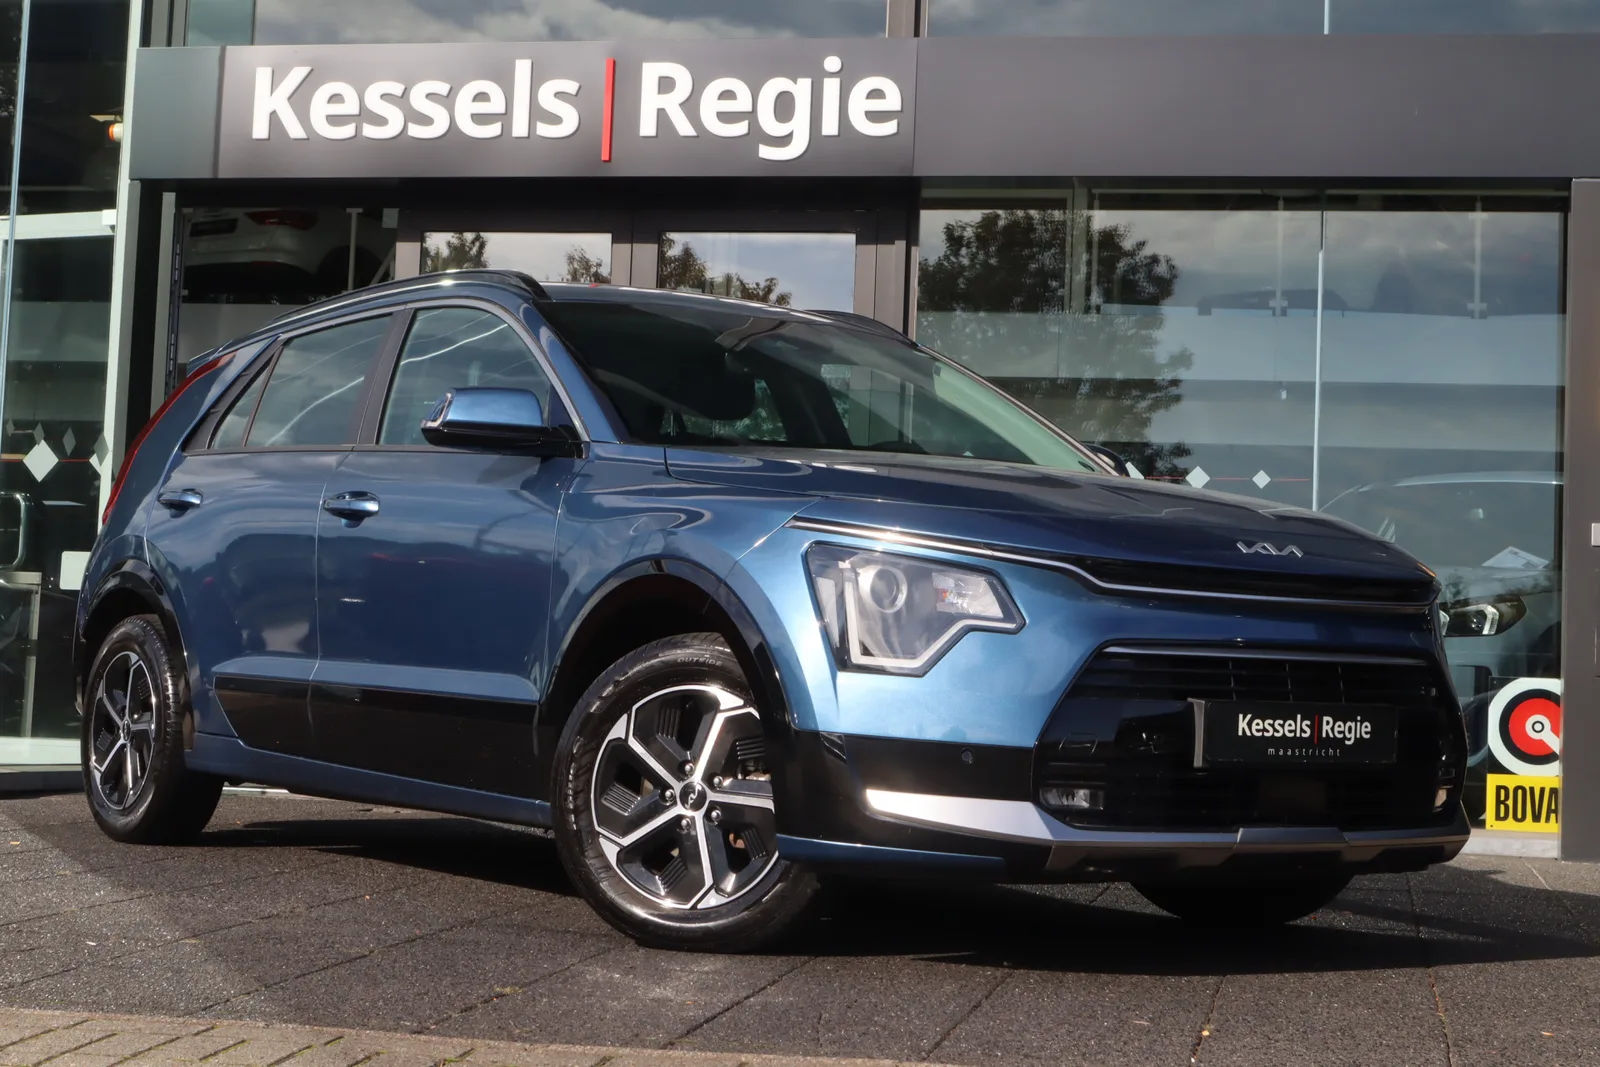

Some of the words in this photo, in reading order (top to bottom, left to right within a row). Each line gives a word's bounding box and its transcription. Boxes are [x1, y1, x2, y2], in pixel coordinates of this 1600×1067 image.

[251, 59, 580, 140] Kessels
[639, 55, 903, 161] Regie
[1237, 713, 1311, 737] Kessels
[1321, 716, 1371, 744] Regie
[1267, 747, 1340, 756] maastricht
